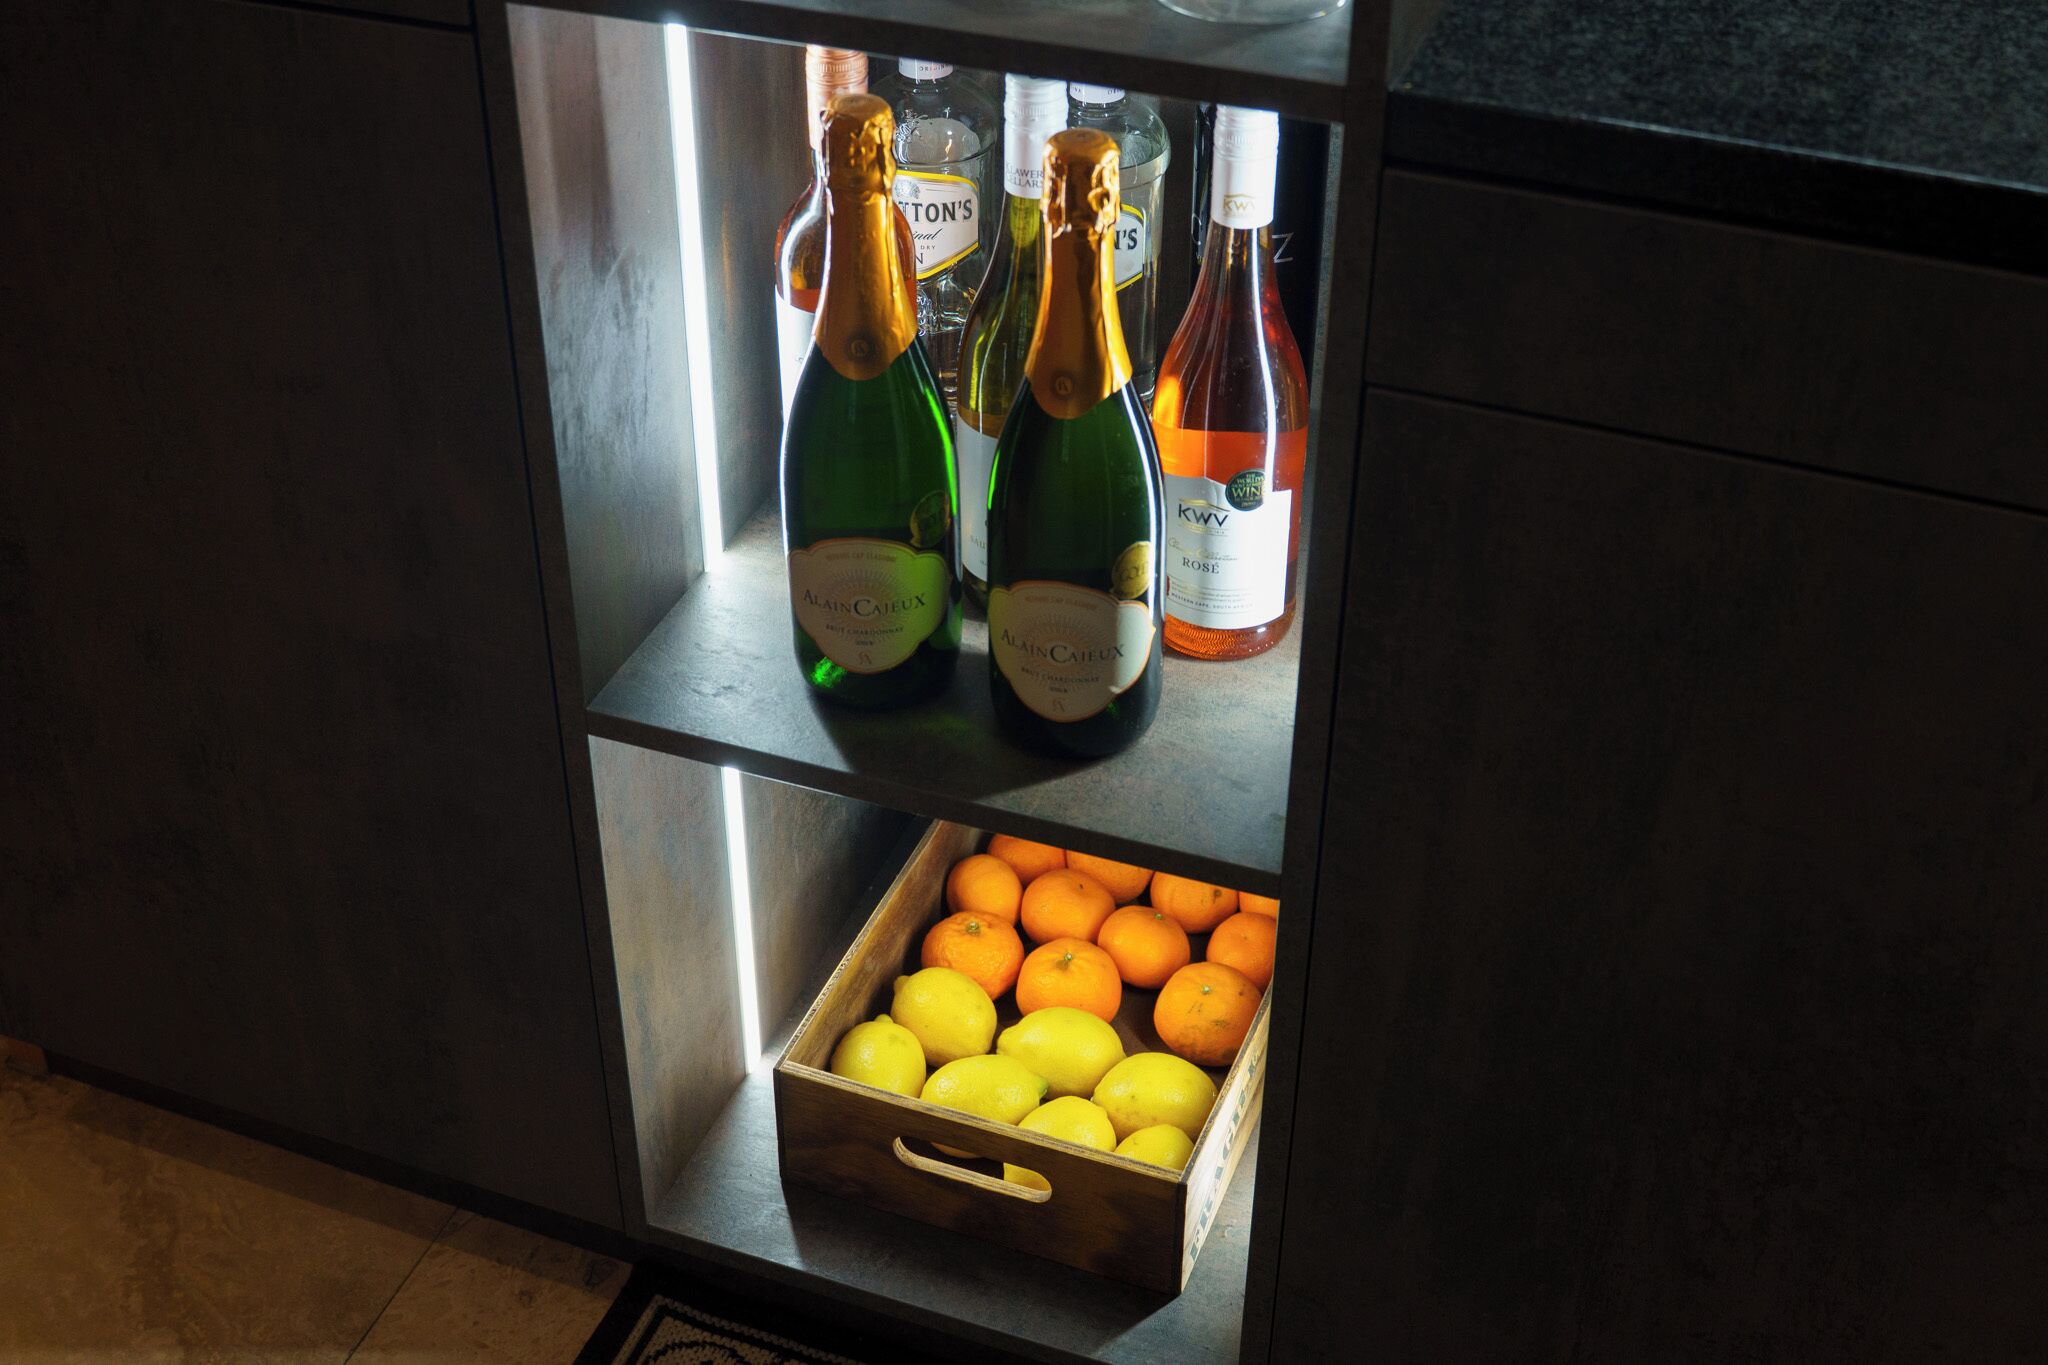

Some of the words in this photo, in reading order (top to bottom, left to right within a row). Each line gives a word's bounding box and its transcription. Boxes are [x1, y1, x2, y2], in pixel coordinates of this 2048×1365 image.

[898, 199, 973, 223] TTON'S
[1231, 486, 1264, 498] WIN
[1178, 503, 1229, 528] KWV
[1182, 556, 1220, 574] ROSÉ
